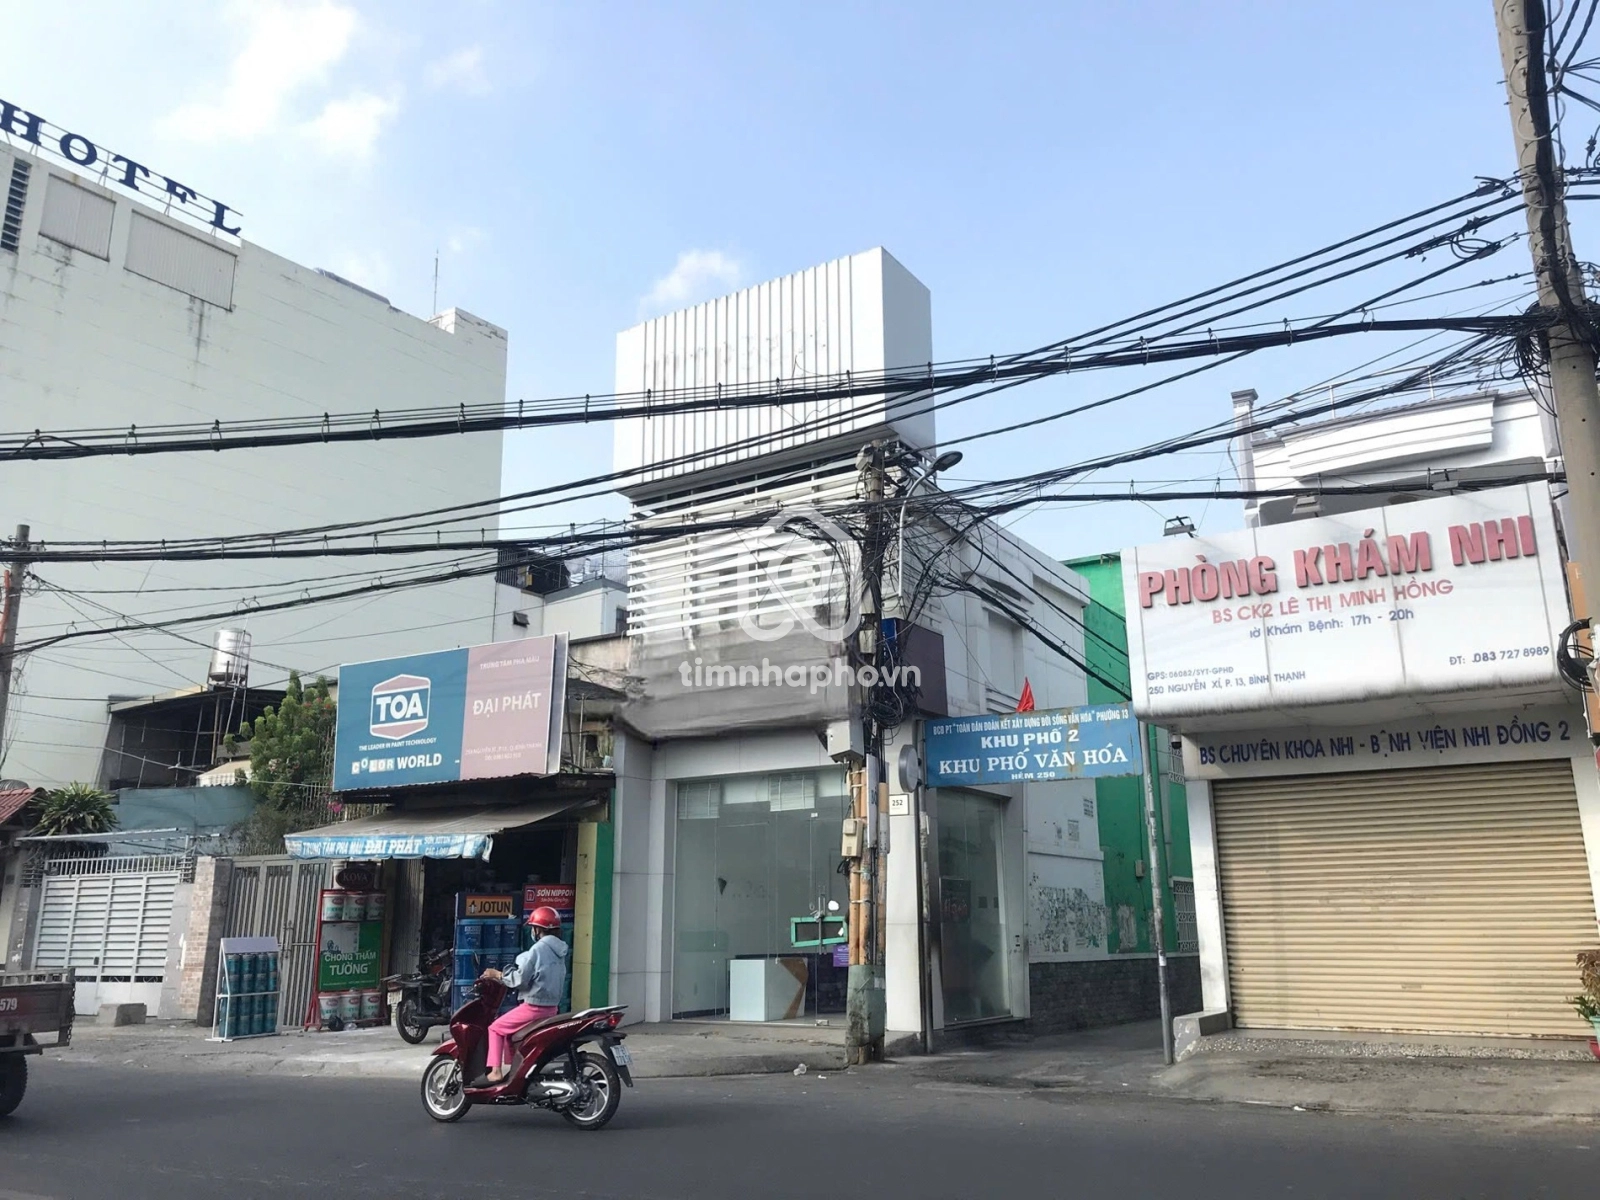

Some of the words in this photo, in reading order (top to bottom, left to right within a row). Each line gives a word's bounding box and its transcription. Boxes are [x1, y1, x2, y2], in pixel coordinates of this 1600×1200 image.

[1139, 554, 1278, 608] PHÒNG
[1293, 528, 1432, 588] KHÁM
[1448, 515, 1537, 566] NHI
[1212, 609, 1233, 624] BS
[1237, 603, 1273, 621] CK2
[1280, 597, 1300, 615] LÊ
[1306, 596, 1332, 612] THỊ
[1340, 588, 1386, 608] MINH
[1393, 576, 1454, 601] HỒNG
[1266, 622, 1302, 637] Khám
[1309, 617, 1343, 632] Bệnh:
[1350, 613, 1371, 627] 17h
[1389, 608, 1414, 622] 20h
[1449, 656, 1466, 665] ĐT:
[1500, 649, 1520, 660] 727
[1523, 646, 1550, 657] 8989
[1148, 686, 1164, 695] 250
[1168, 679, 1206, 693] NGUYỄN
[1225, 680, 1233, 688] P.
[1235, 678, 1246, 687] 13,
[1249, 674, 1270, 685] BÌNH
[1274, 671, 1306, 684] THẠNH
[375, 692, 424, 722] TOA
[473, 698, 499, 718] ĐẠI
[502, 690, 542, 712] PHÁT
[945, 725, 952, 734] PT
[1052, 713, 1068, 726] SỐNG
[1096, 708, 1120, 721] PHƯỜNG
[1121, 709, 1129, 719] 13
[981, 734, 1018, 749] KHU
[1023, 727, 1062, 746] PHỐ
[1068, 729, 1079, 742] 2
[1200, 746, 1216, 765] BS
[1219, 739, 1281, 763] CHUYÊN
[1285, 739, 1325, 760] KHOA
[1330, 736, 1354, 757] NHI
[1463, 726, 1490, 747] NHI
[1497, 715, 1551, 745] ĐỒNG
[1558, 720, 1570, 741] 2
[397, 753, 442, 769] WORLD
[939, 758, 980, 774] KHU
[987, 747, 1030, 772] PHỐ
[1034, 748, 1076, 768] VĂN
[1082, 742, 1129, 765] HÓA
[1037, 771, 1056, 779] 250
[892, 799, 903, 807] 252
[388, 835, 422, 854] PHÁT
[343, 872, 368, 881] KOVA
[537, 887, 550, 897] SƠN
[550, 889, 574, 897] NIPPON
[478, 901, 511, 913] JOTUN
